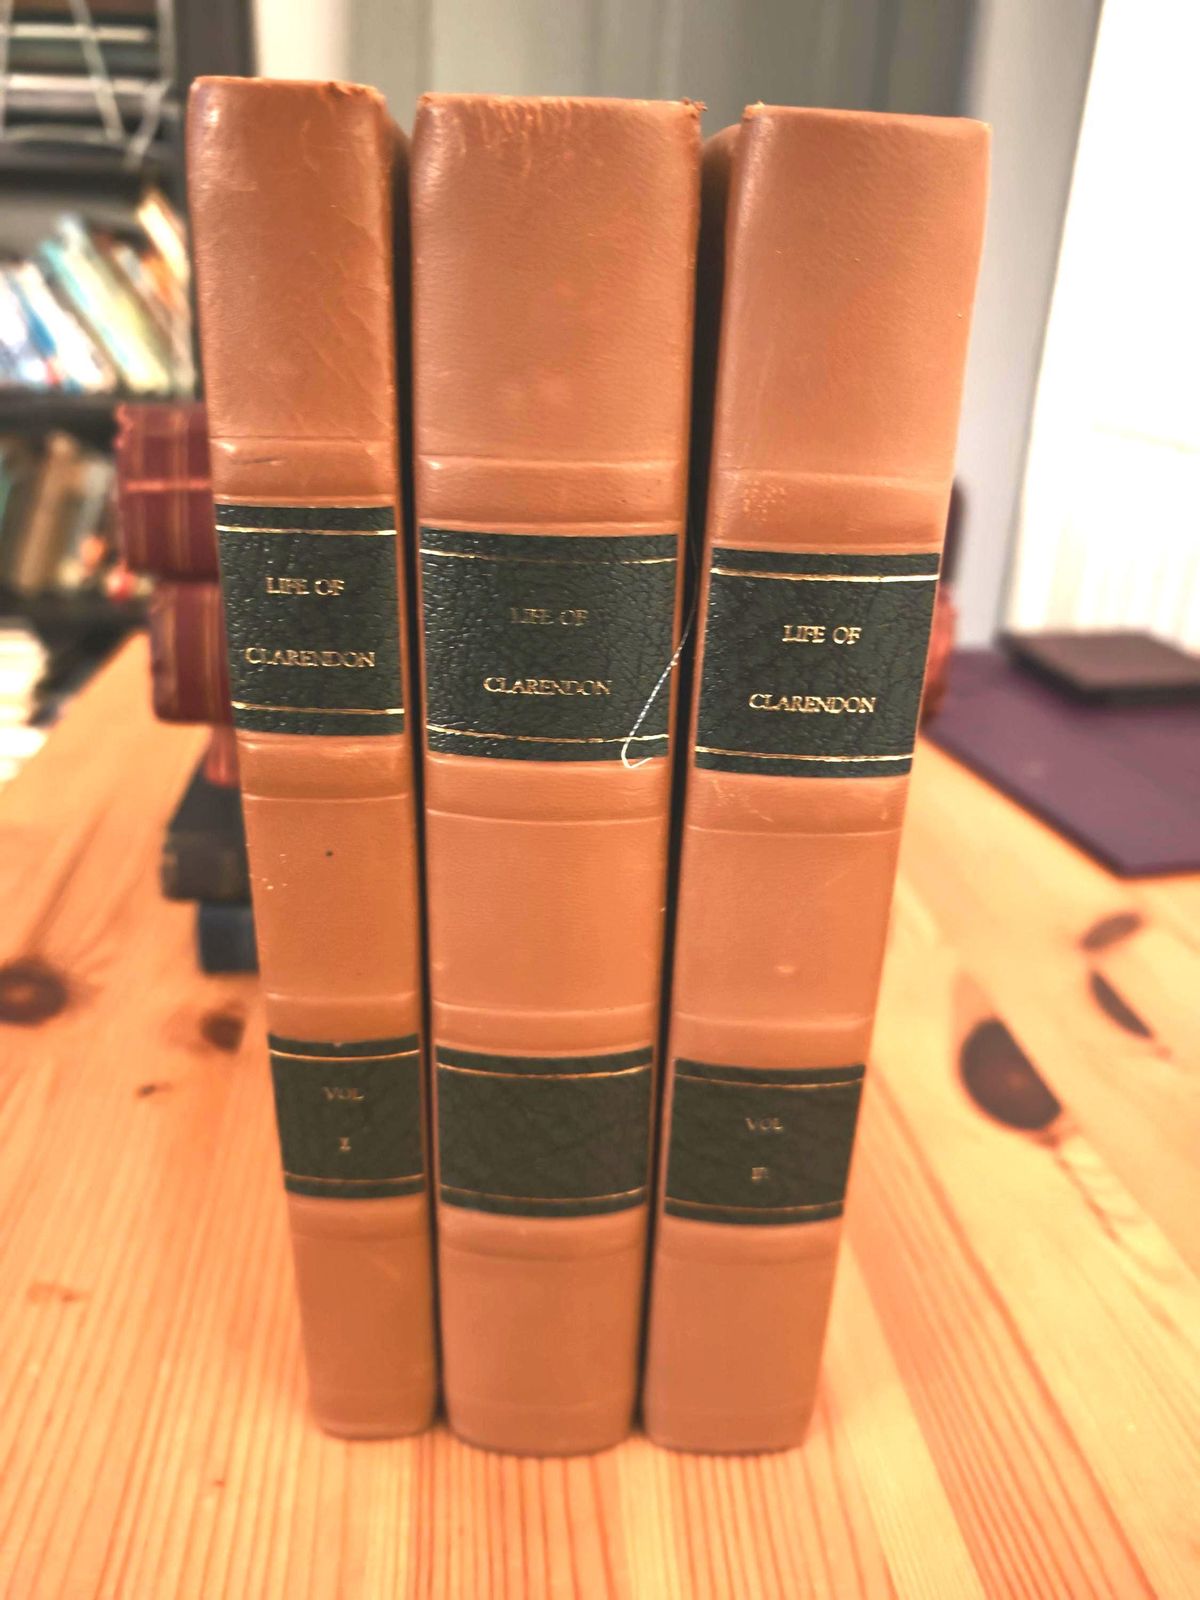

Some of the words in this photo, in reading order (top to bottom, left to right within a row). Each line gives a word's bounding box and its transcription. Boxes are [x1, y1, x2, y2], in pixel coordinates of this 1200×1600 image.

[265, 576, 310, 594] LIFE
[314, 578, 345, 596] OF
[560, 609, 589, 626] OF
[782, 624, 826, 643] LIFE
[832, 625, 862, 645] OF
[244, 647, 375, 667] CLARENDON
[482, 676, 613, 696] CLARENDON
[748, 693, 877, 714] CLARENDON
